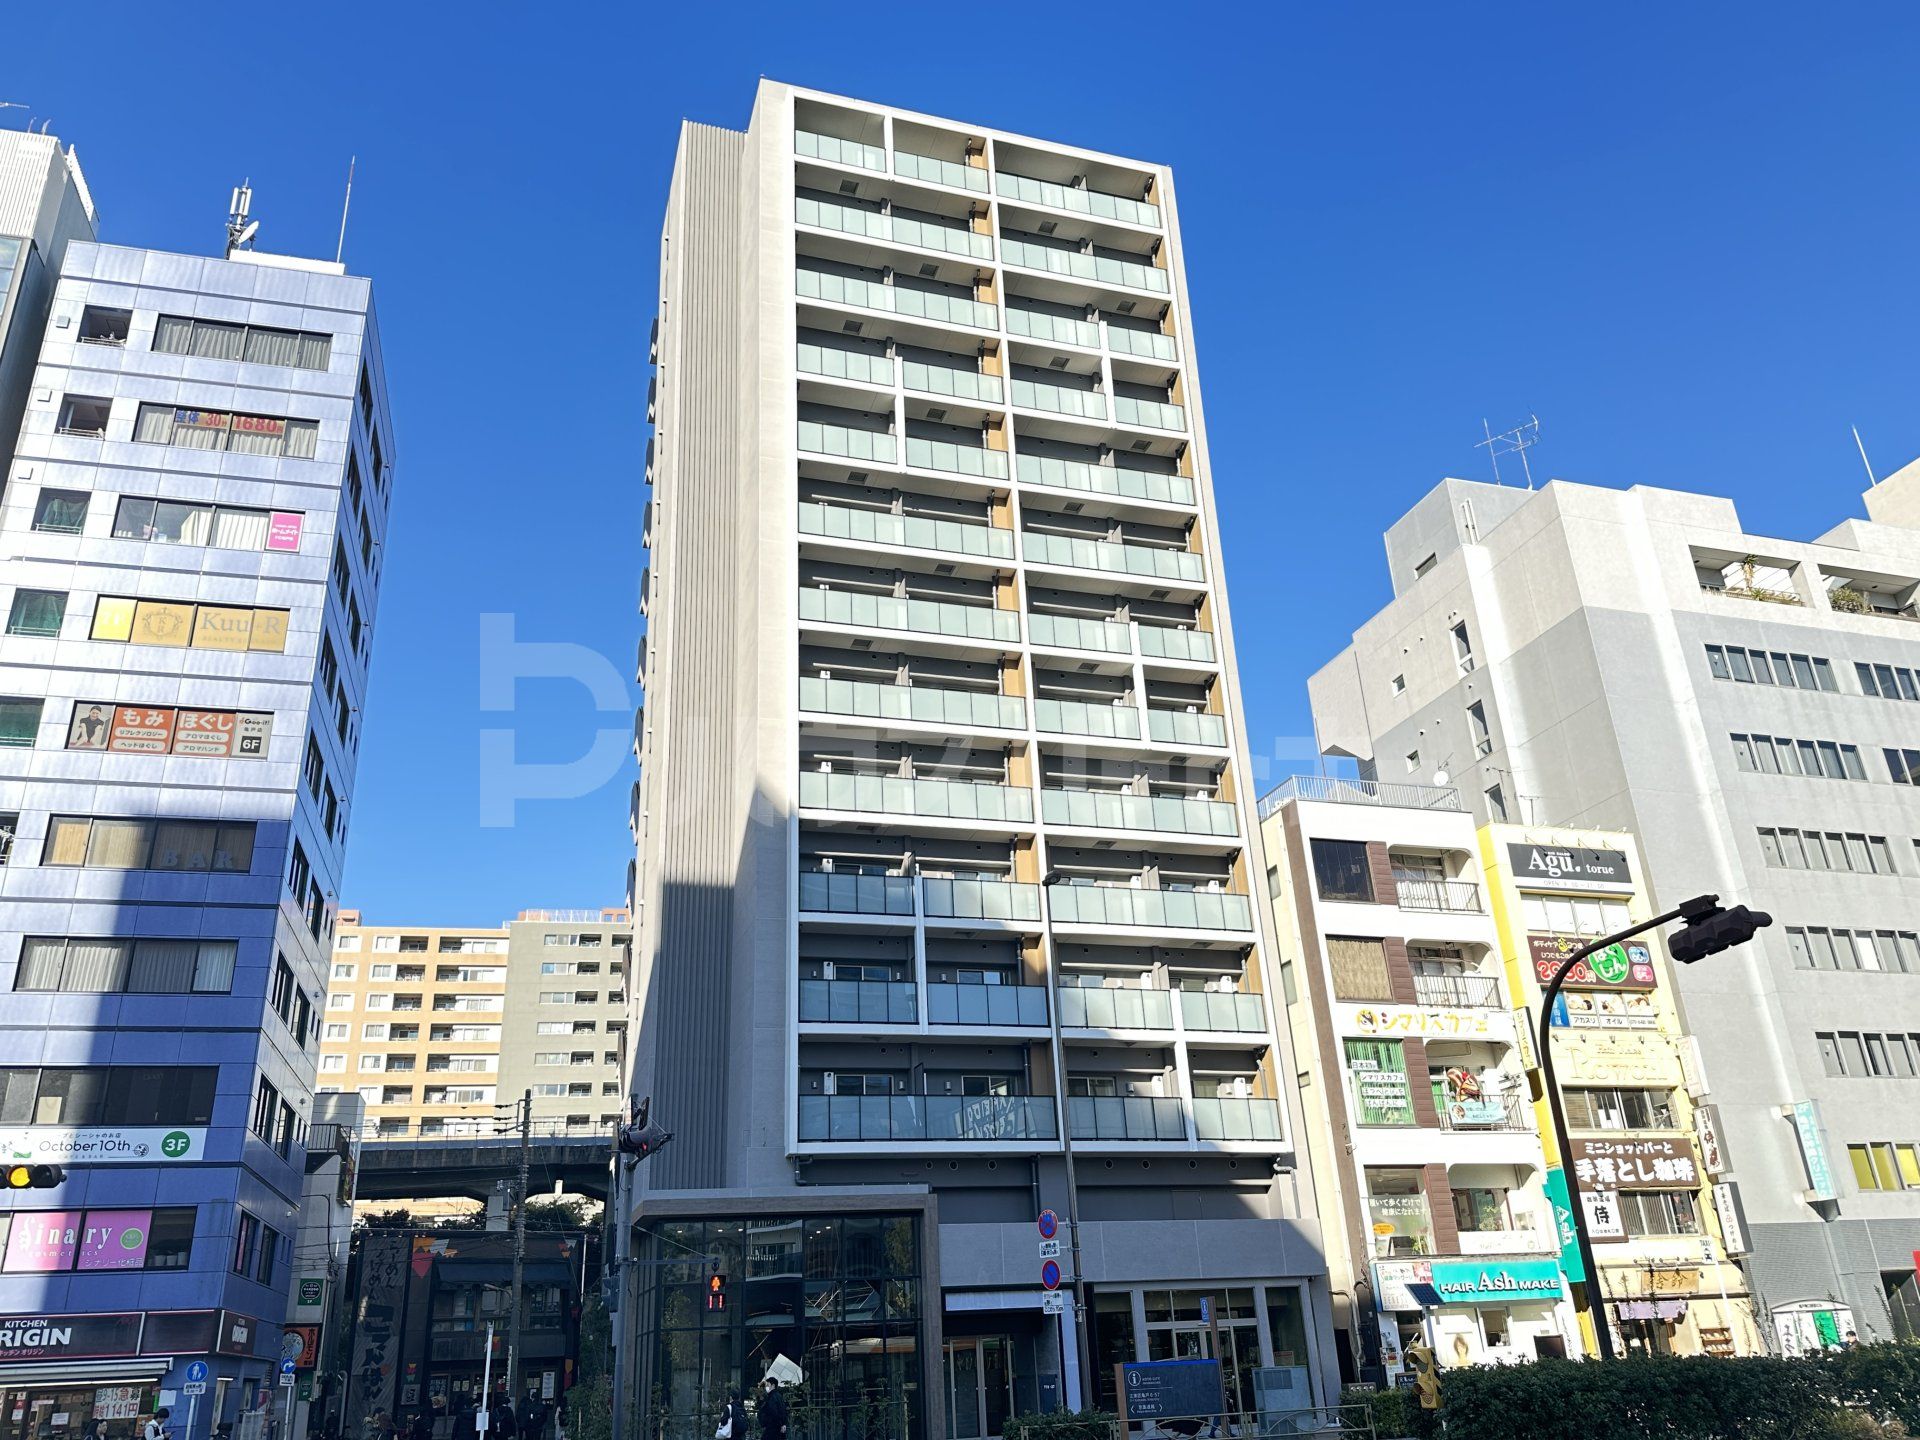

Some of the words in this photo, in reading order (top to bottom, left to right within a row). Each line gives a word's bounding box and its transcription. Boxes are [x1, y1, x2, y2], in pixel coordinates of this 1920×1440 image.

[179, 712, 233, 731] ほぐし
[242, 739, 260, 750] 6F
[1529, 848, 1581, 877] Agu.
[1586, 863, 1615, 876] torue
[1381, 1012, 1489, 1033] シマリスカフェ
[1605, 1017, 1623, 1025] オイル
[164, 1138, 187, 1152] 3F
[1585, 1141, 1674, 1155] ミニショットバーと
[1594, 1205, 1610, 1225] 侍
[1556, 1205, 1575, 1246] Ash
[84, 1257, 144, 1267] シナリー化粧品
[1440, 1281, 1475, 1294] HAIR
[1477, 1272, 1517, 1292] Ash
[1518, 1279, 1559, 1291] MAKE
[4, 1319, 48, 1329] KITCHEN
[0, 1327, 72, 1348] RIGIN
[306, 1327, 316, 1360] ホルモン
